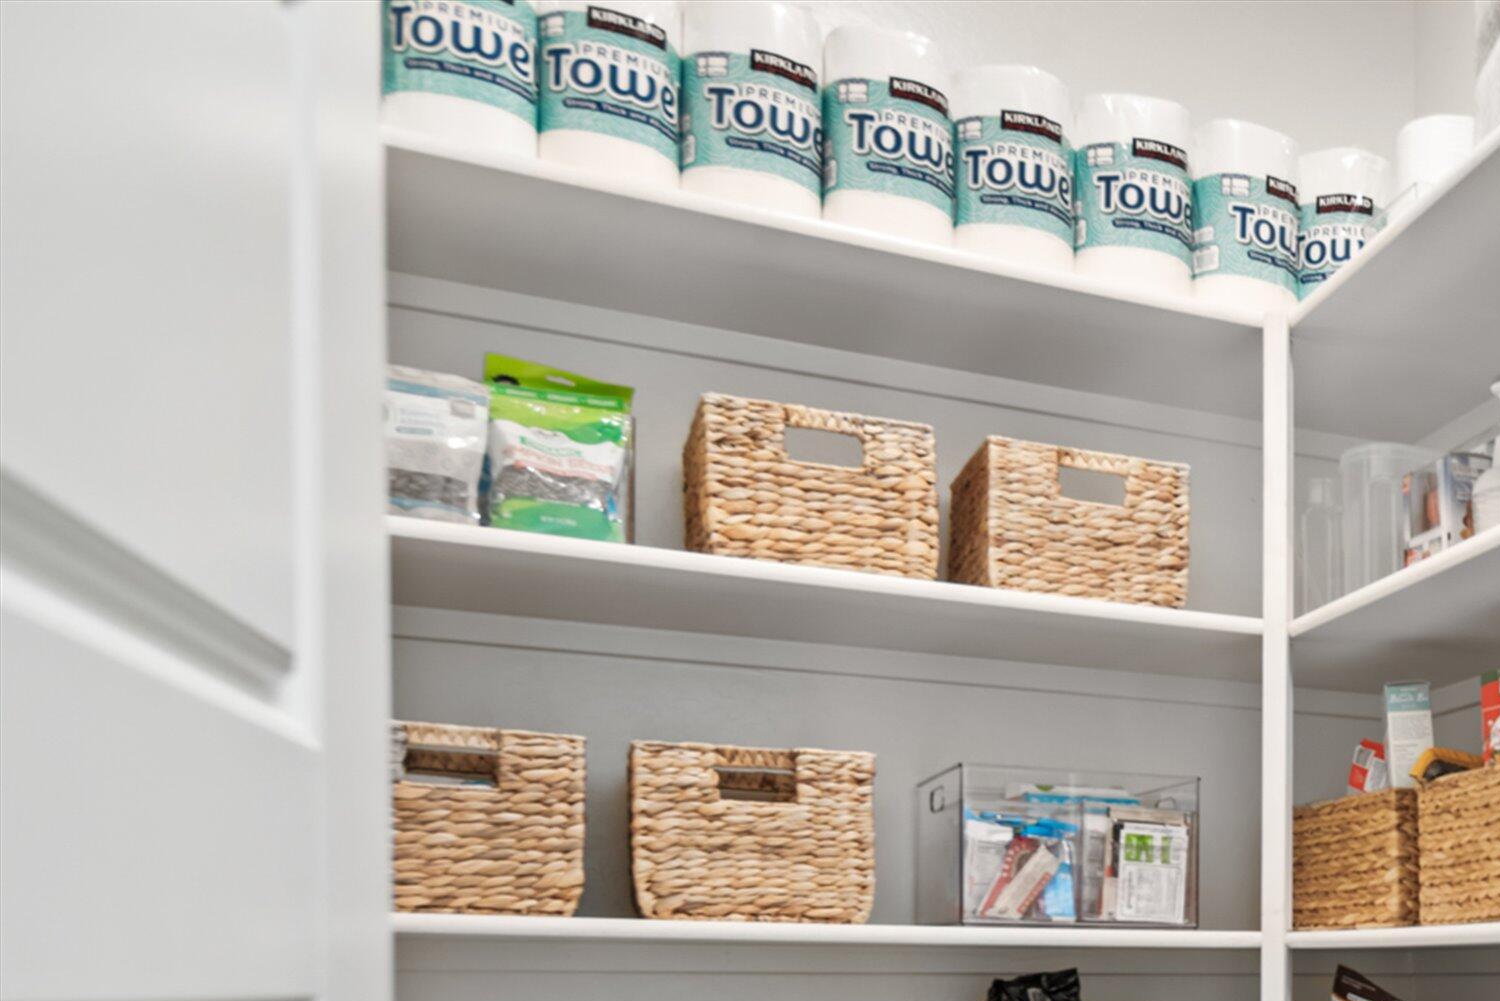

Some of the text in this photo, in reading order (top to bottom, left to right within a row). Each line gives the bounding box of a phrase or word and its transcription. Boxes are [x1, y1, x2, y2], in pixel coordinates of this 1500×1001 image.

[391, 6, 531, 78] Towe
[547, 48, 676, 120] Towe
[966, 150, 1072, 207] Towe
